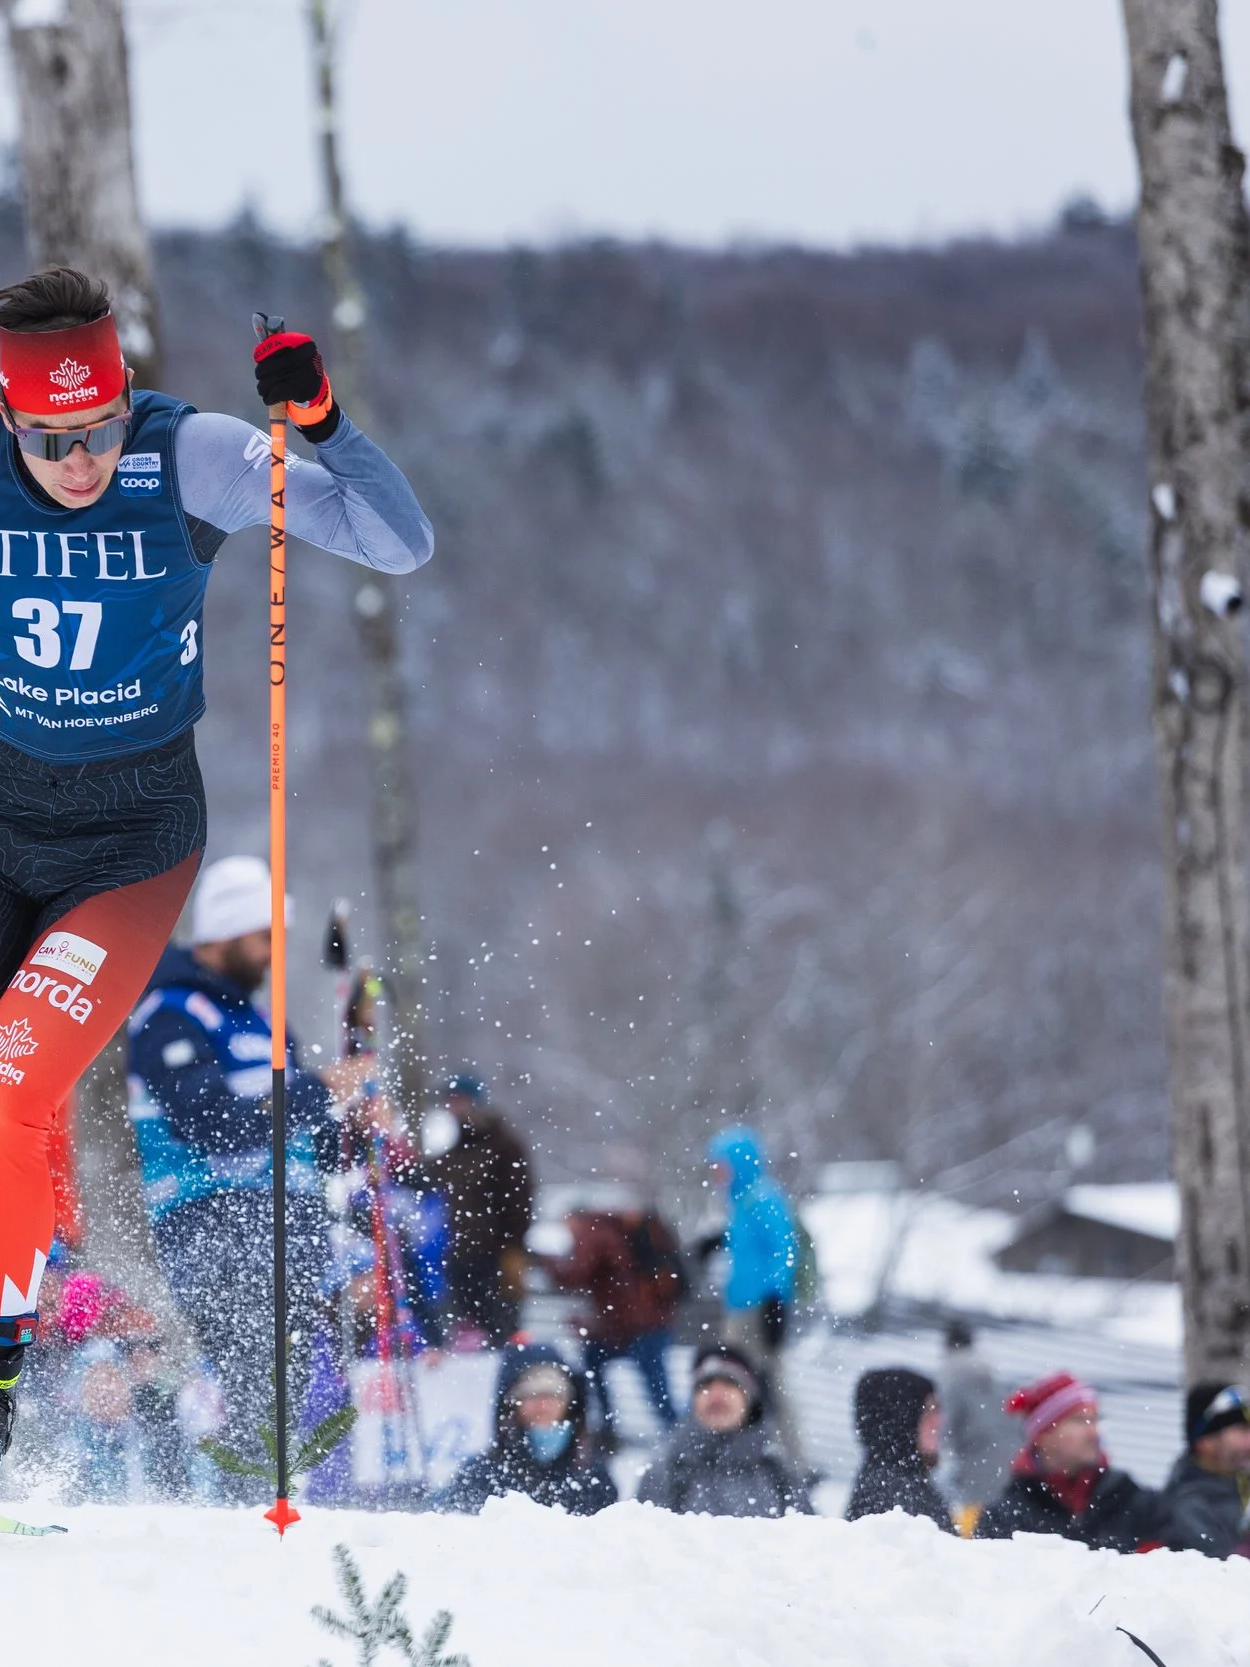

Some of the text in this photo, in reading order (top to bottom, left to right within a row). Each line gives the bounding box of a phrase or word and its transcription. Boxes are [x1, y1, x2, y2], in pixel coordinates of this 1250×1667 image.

[49, 386, 98, 402] nordiq
[55, 396, 93, 406] CANADA
[120, 478, 160, 490] coop
[11, 597, 103, 671] 37
[55, 679, 141, 706] Placid
[15, 703, 159, 729] MT VAN HOEVENBERG
[272, 723, 280, 790] PREMIO 40
[38, 946, 57, 955] CAN
[64, 951, 97, 973] FUND
[7, 969, 93, 1025] norda
